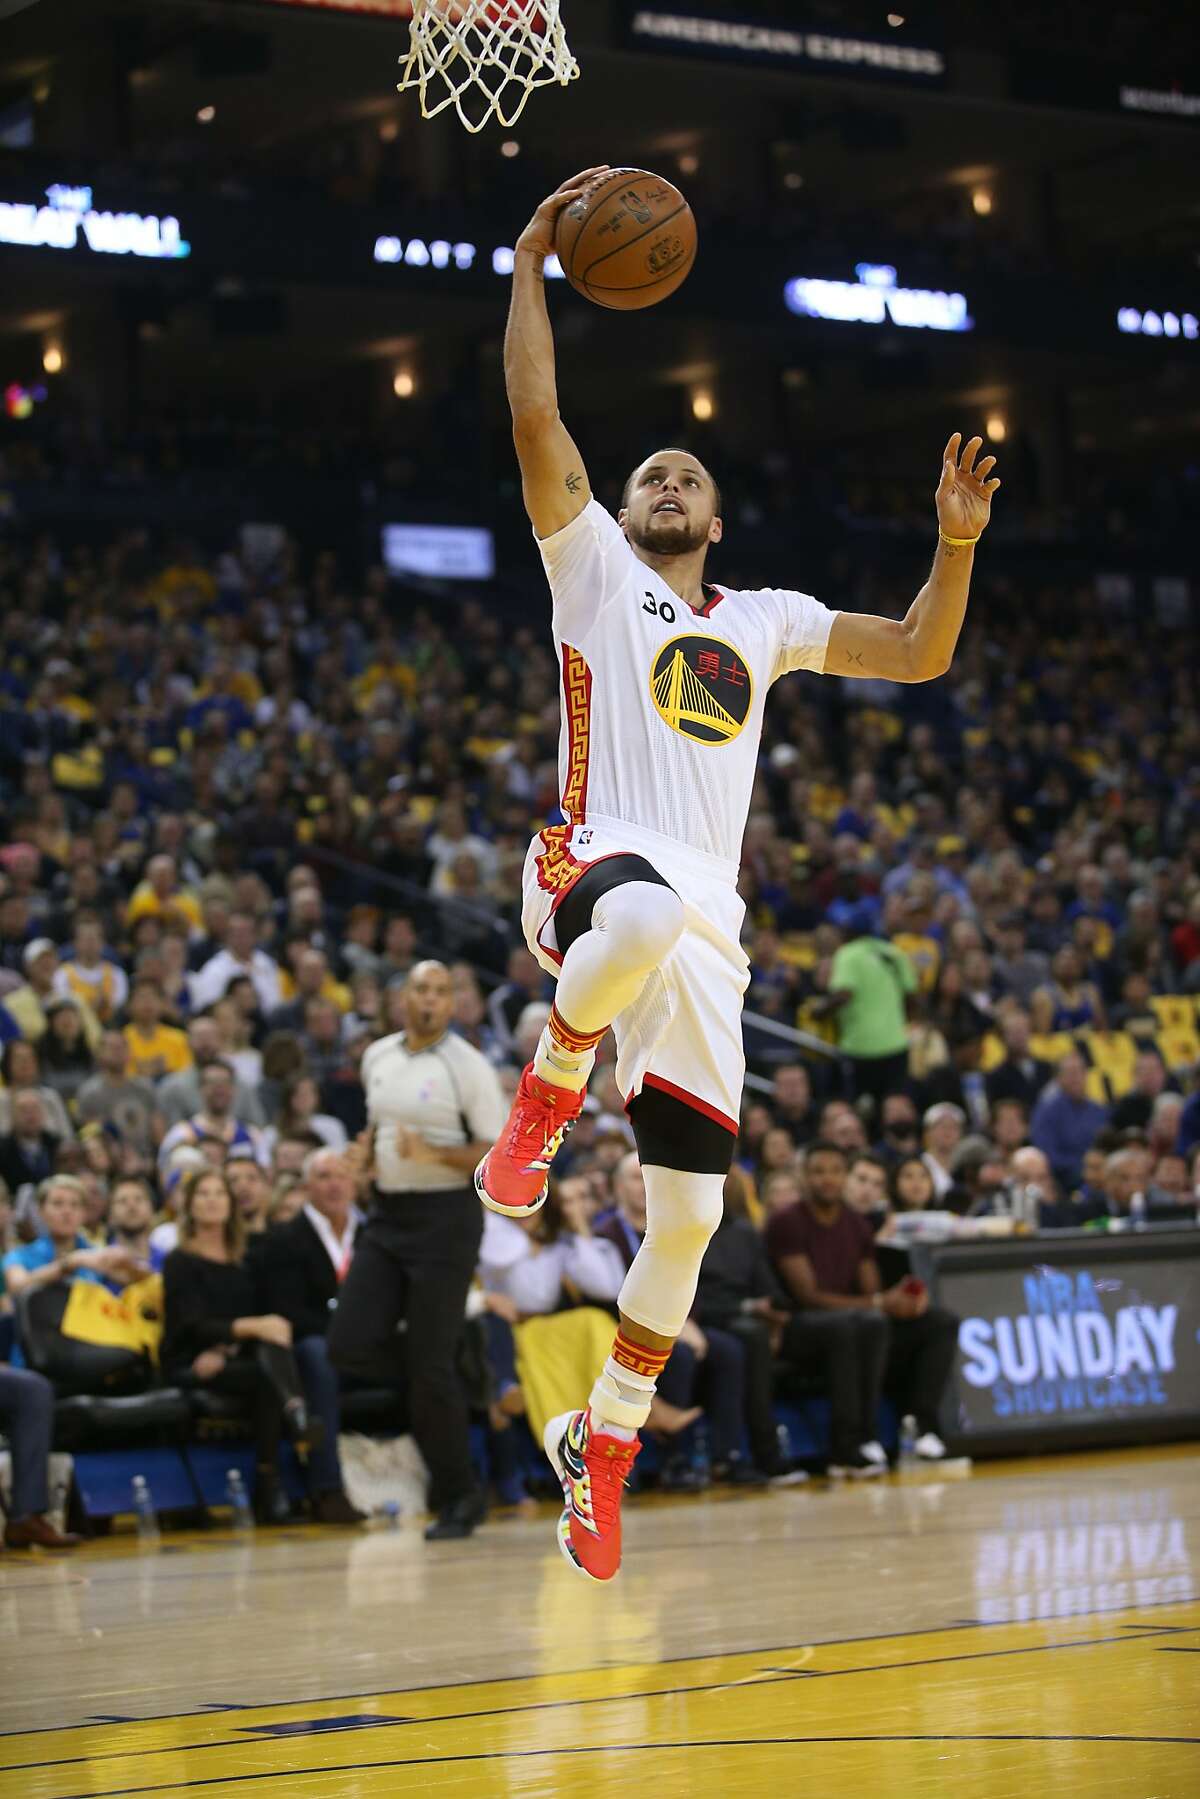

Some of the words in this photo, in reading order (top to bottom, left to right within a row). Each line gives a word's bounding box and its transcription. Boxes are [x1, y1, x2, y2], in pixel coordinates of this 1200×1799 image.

[633, 11, 802, 55] AMERICAN
[805, 34, 945, 75] EXPRESS
[642, 591, 676, 624] 30
[694, 649, 748, 687] 勇士
[1024, 1270, 1104, 1313] NBA
[958, 1304, 1178, 1388] SUNDAY
[992, 1369, 1168, 1417] SHOWCASE
